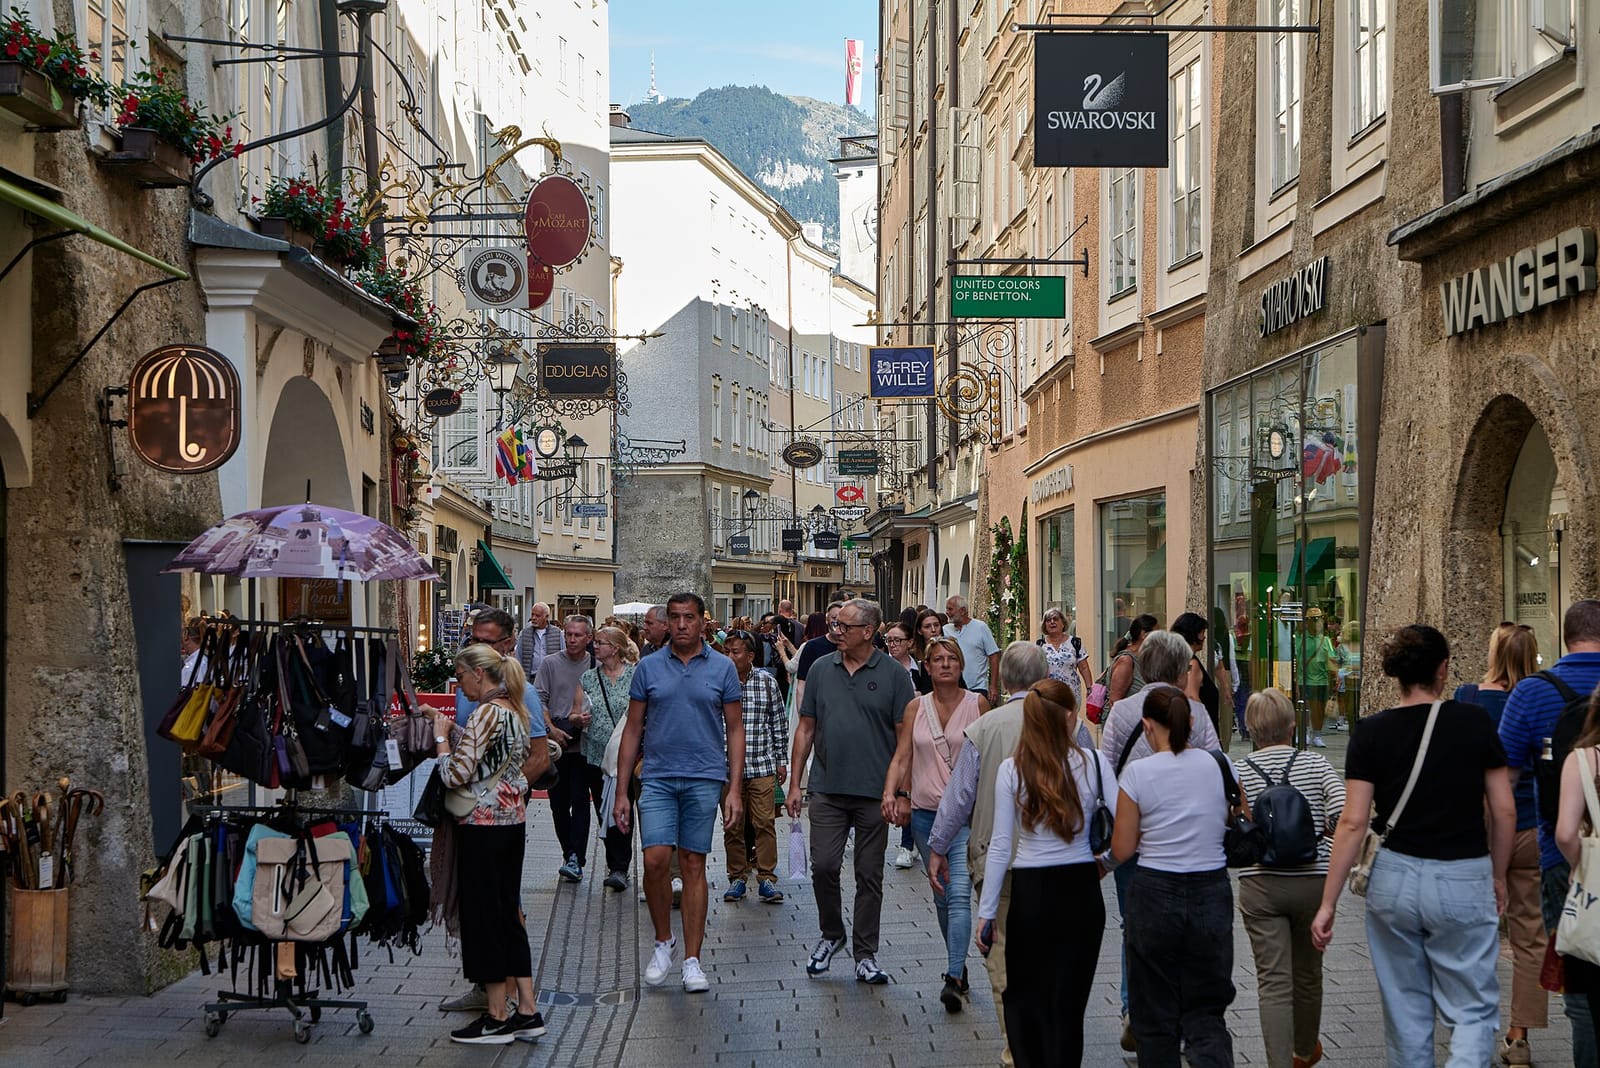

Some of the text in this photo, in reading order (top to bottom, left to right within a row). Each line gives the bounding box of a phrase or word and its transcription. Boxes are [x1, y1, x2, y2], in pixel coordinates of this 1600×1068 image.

[1047, 111, 1156, 129] SWAROVSKI
[538, 217, 586, 228] MOZART
[473, 252, 518, 270] HENRI WILLIG
[955, 279, 1040, 290] UNITED COLORS
[1440, 226, 1594, 336] WANGER
[955, 291, 1032, 301] OF BENETTON.
[1259, 256, 1327, 338] SWAROVSKI
[545, 365, 608, 378] DOUGLAS
[892, 361, 930, 374] FREY
[877, 374, 927, 386] WILLE
[427, 399, 459, 407] DOUGLAS
